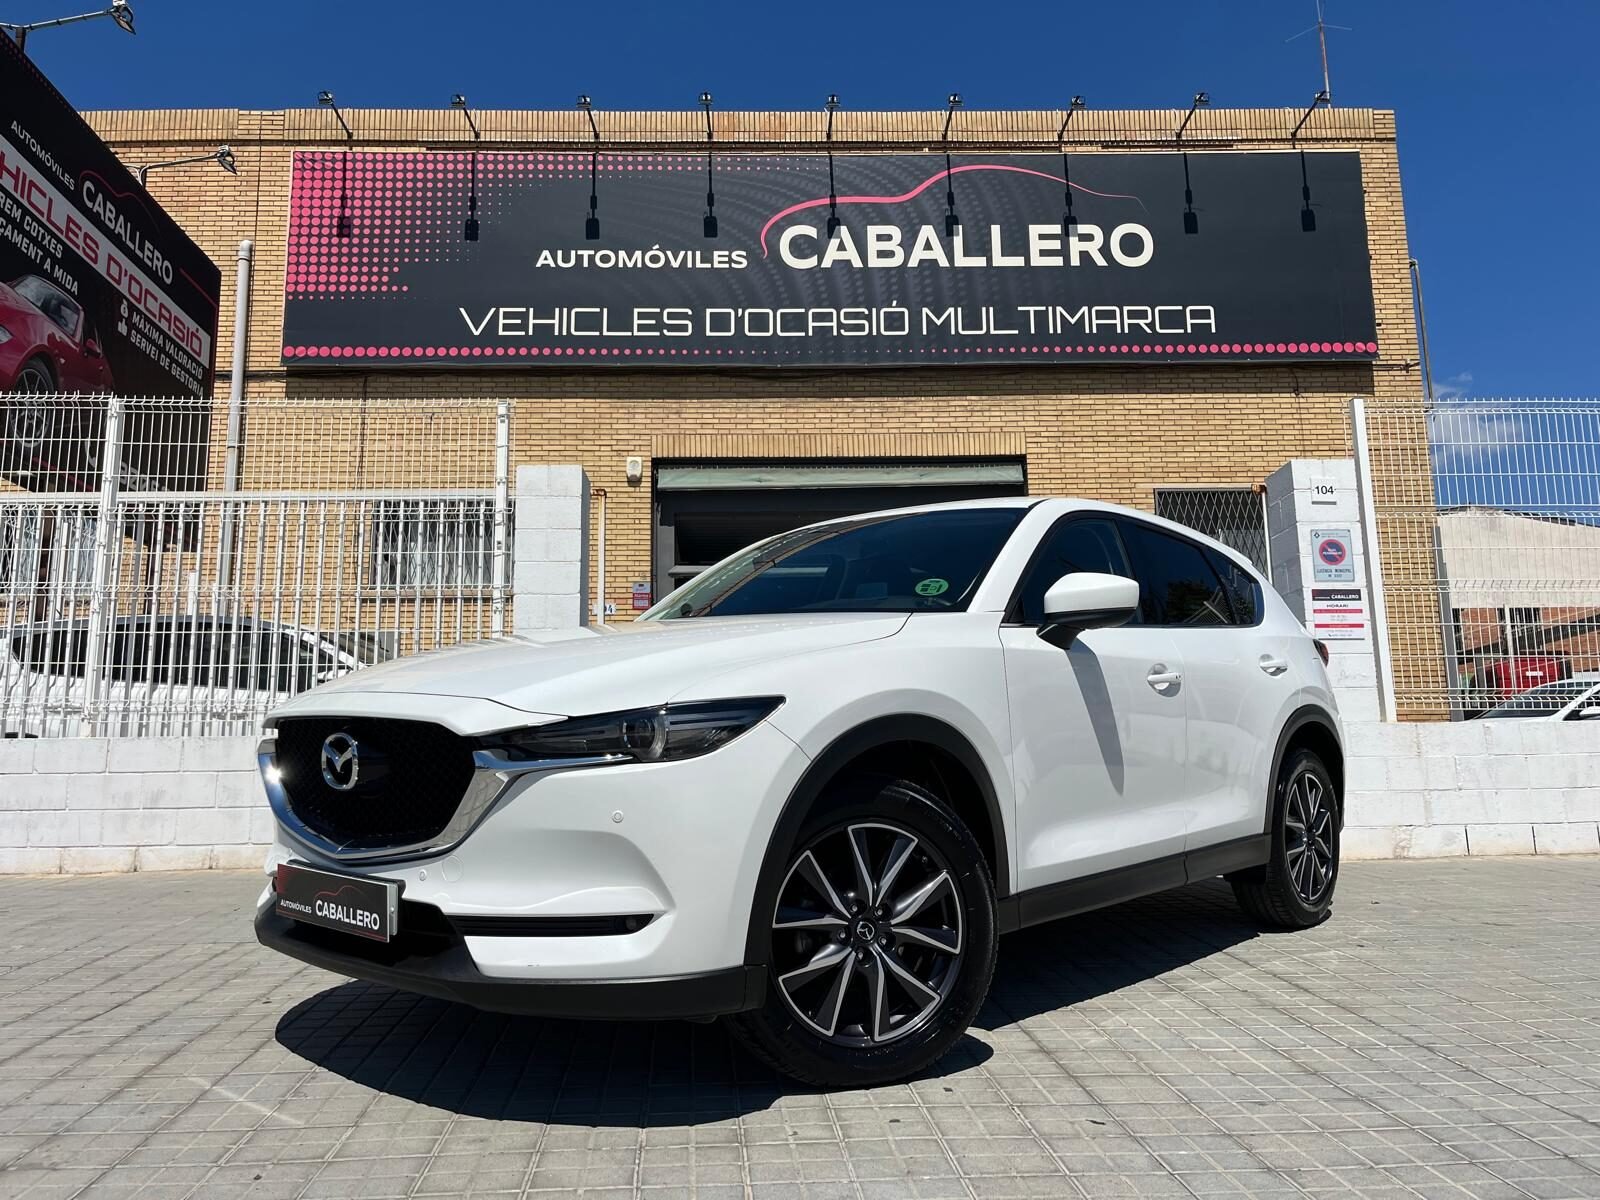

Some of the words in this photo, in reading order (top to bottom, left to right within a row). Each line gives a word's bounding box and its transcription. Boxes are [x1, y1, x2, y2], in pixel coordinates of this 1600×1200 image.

[11, 120, 75, 191] AUTOMÓVILES
[83, 180, 173, 284] CABALLERO
[24, 215, 63, 259] COTXES
[535, 244, 748, 268] AUTOMÓVILES
[779, 223, 1154, 269] CABALLERO
[44, 257, 51, 273] A
[54, 265, 78, 295] MIDA
[106, 253, 202, 358] D'OCASIÓ
[459, 307, 693, 336] VEHICLES
[705, 300, 910, 337] D'OCASIÓ
[922, 305, 1216, 335] MULTIMARCA
[130, 330, 158, 360] SERVEI
[160, 354, 170, 370] DE
[171, 363, 204, 398] GESTORIA
[165, 339, 203, 380] VALORACIÓ
[1315, 485, 1334, 495] 104
[280, 898, 312, 914] AUTOMÓVILES
[315, 900, 380, 930] CABALLERO
